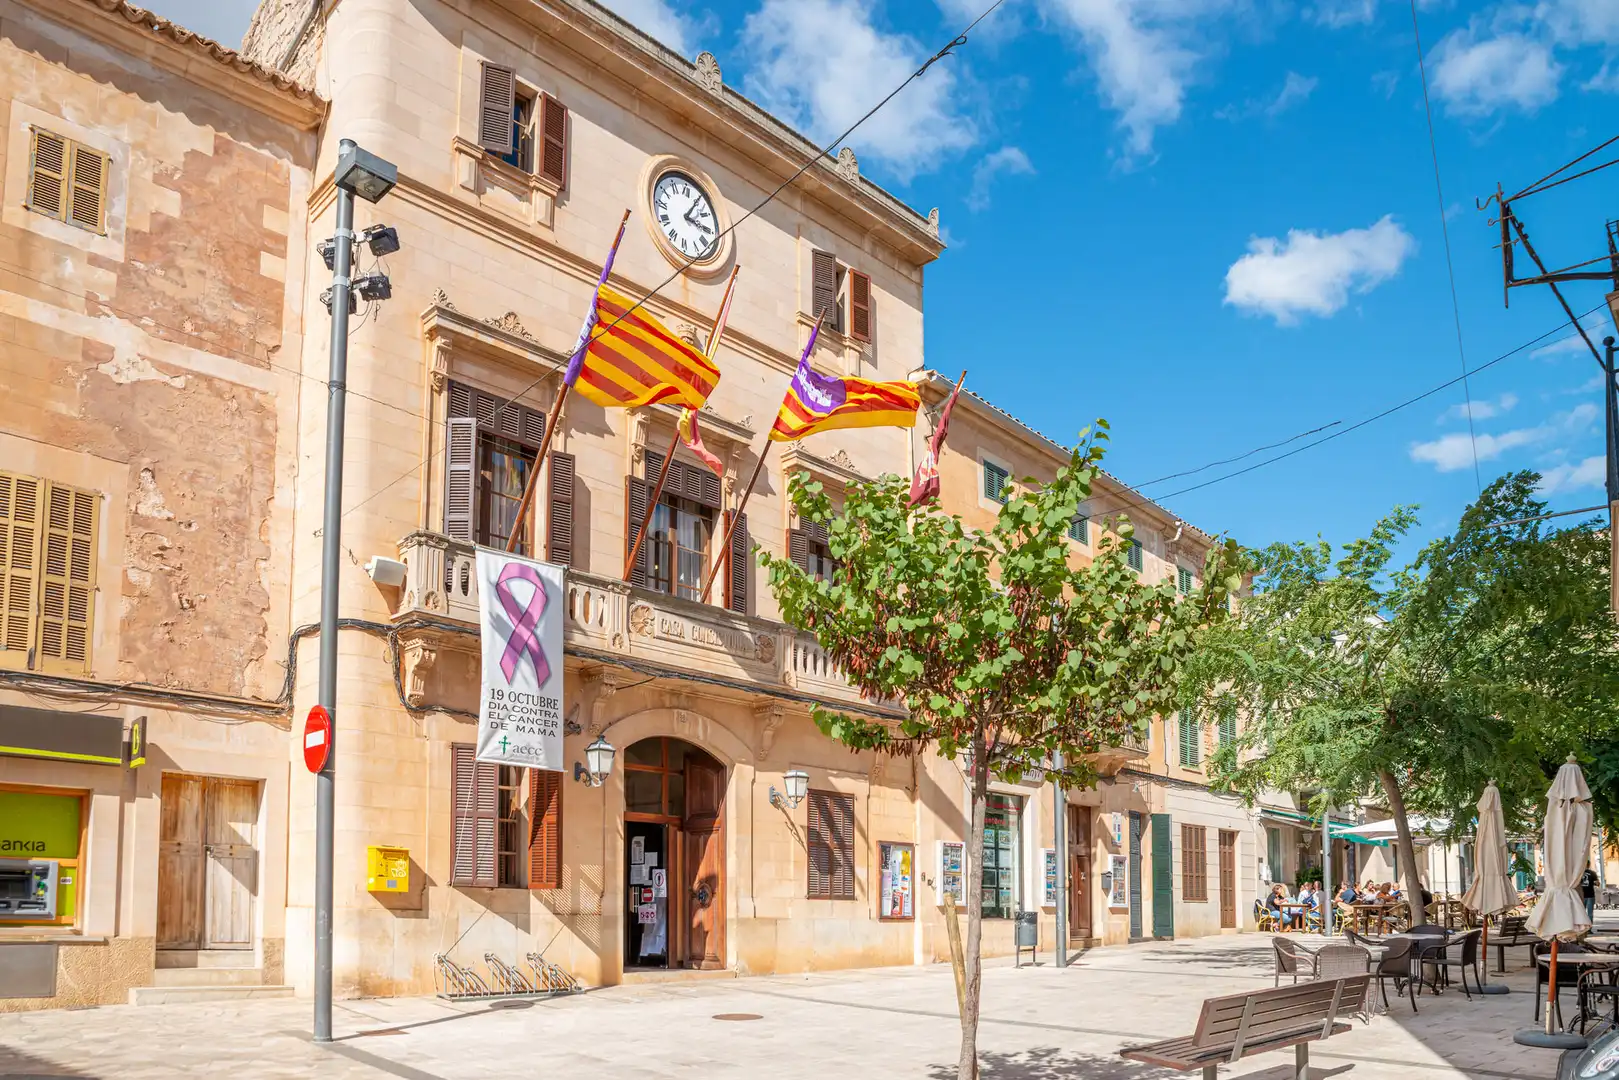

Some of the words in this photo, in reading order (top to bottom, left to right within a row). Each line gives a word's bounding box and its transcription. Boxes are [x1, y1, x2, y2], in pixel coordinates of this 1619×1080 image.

[660, 617, 685, 639] CASA
[490, 688, 504, 701] 19
[508, 691, 559, 711] OCTUBRE
[488, 701, 509, 711] DIA
[511, 705, 559, 719] CONTRA
[488, 711, 505, 720] EL
[507, 714, 558, 728] CANCER
[490, 721, 509, 731] DE
[516, 725, 556, 737] MAMA
[512, 744, 542, 756] aecc
[0, 839, 46, 852] ankia
